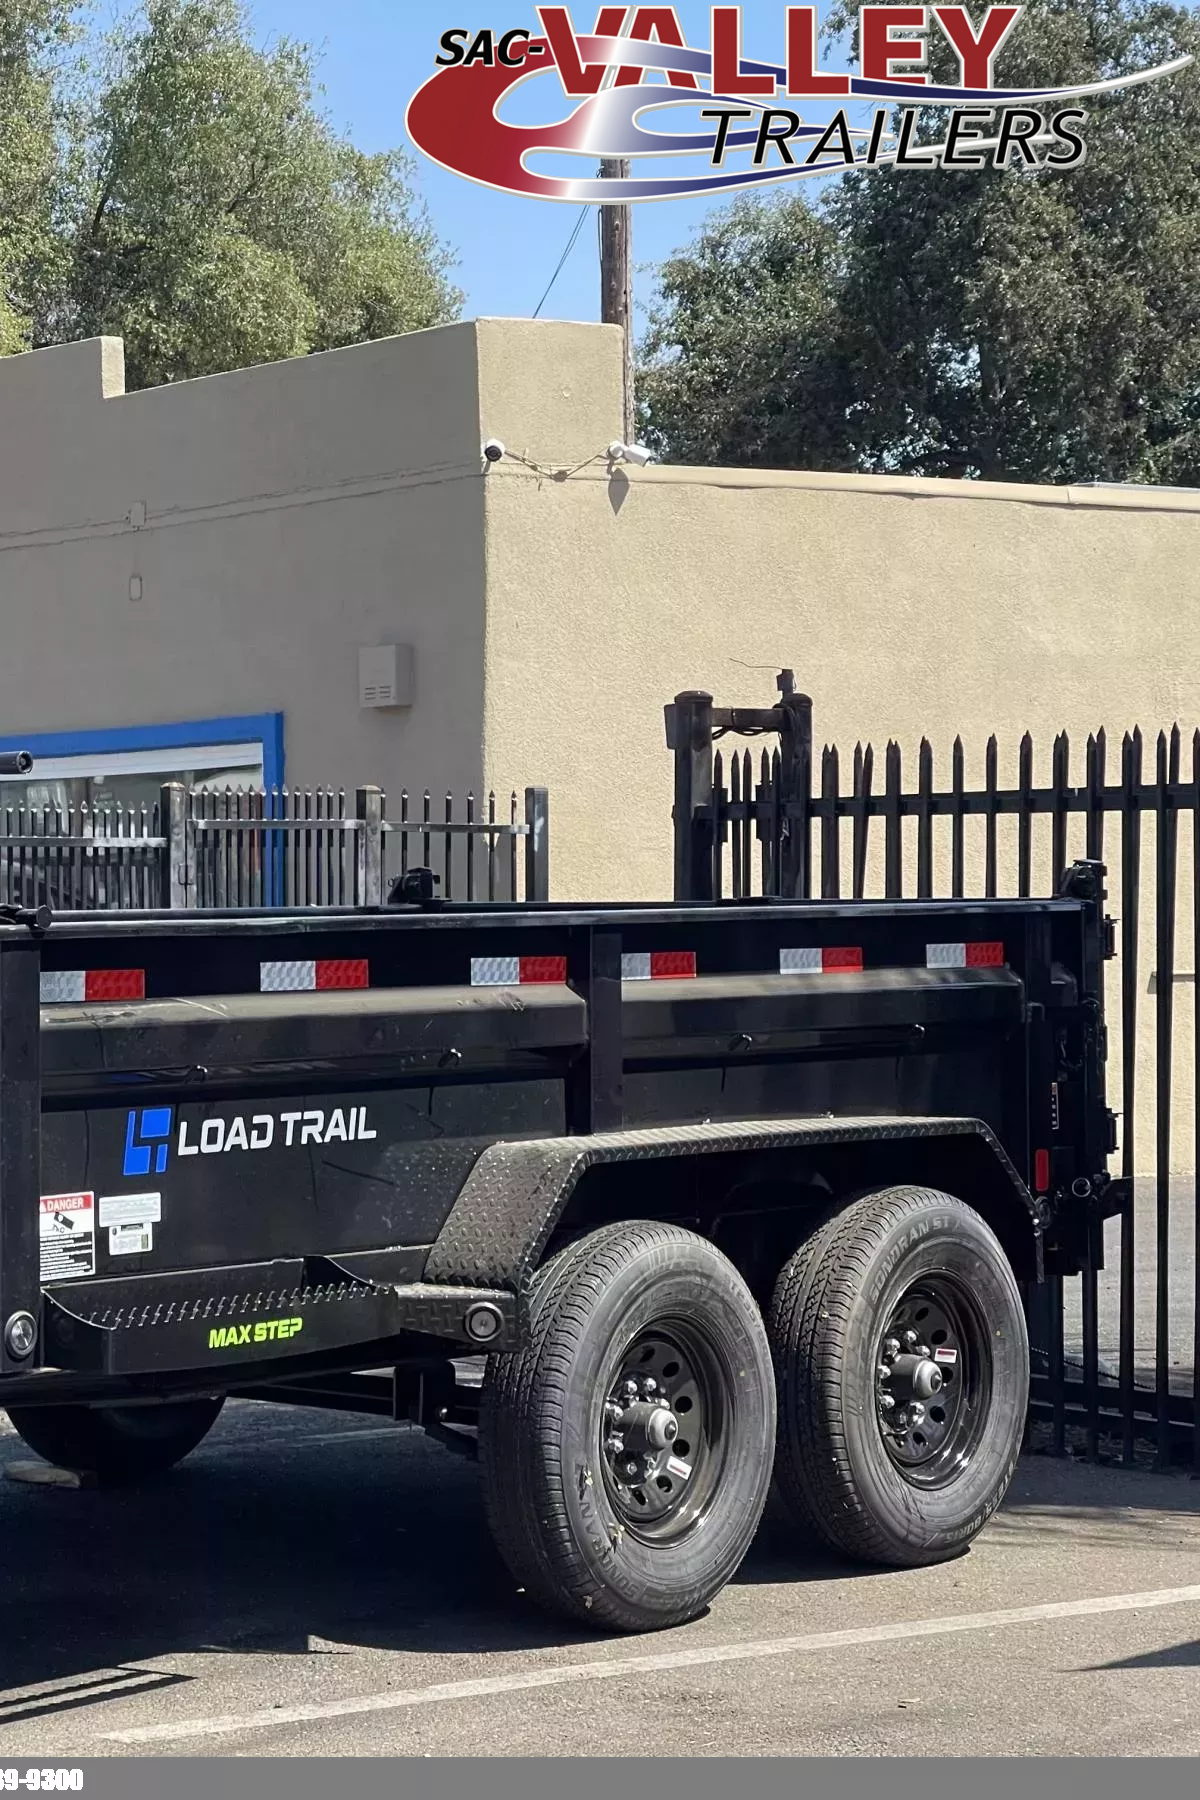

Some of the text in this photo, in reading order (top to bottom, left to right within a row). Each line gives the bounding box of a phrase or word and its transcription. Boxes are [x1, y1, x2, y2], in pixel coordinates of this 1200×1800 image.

[177, 1106, 377, 1156] LOAD TRAIL
[46, 1197, 84, 1211] DANGER
[208, 1317, 303, 1349] MAX STEP
